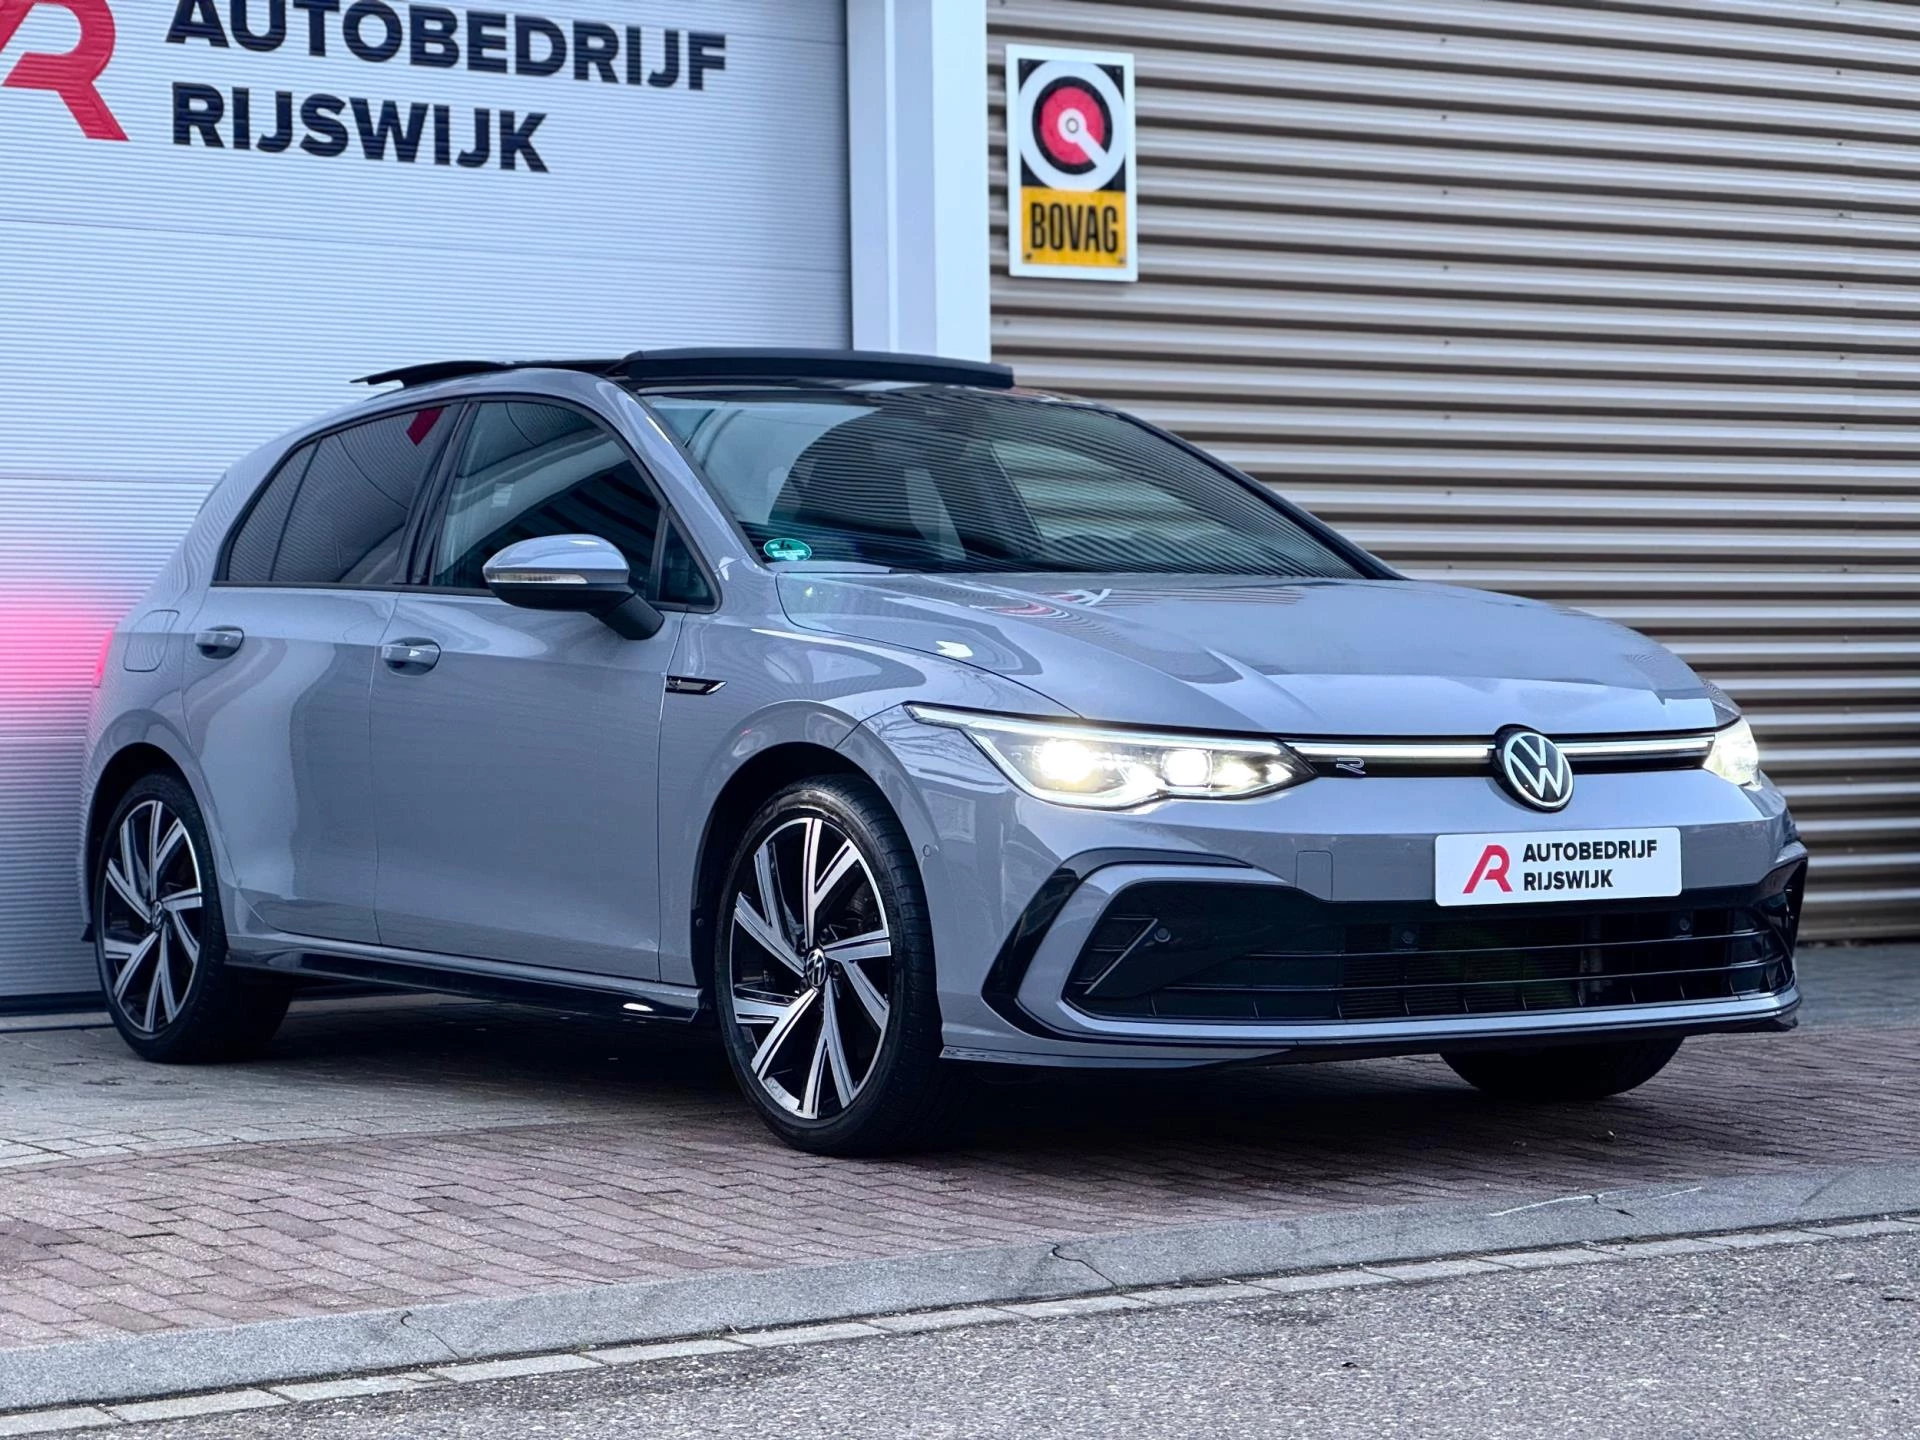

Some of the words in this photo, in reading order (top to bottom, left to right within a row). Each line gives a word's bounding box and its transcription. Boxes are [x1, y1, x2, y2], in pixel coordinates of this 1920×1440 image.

[165, 0, 726, 91] AUTOBEDRIJF
[172, 81, 549, 173] RIJSWIJK
[1030, 201, 1118, 254] BOVAG
[1522, 839, 1658, 863] AUTOBEDRIJF
[1523, 869, 1613, 891] RIJSWIJK
